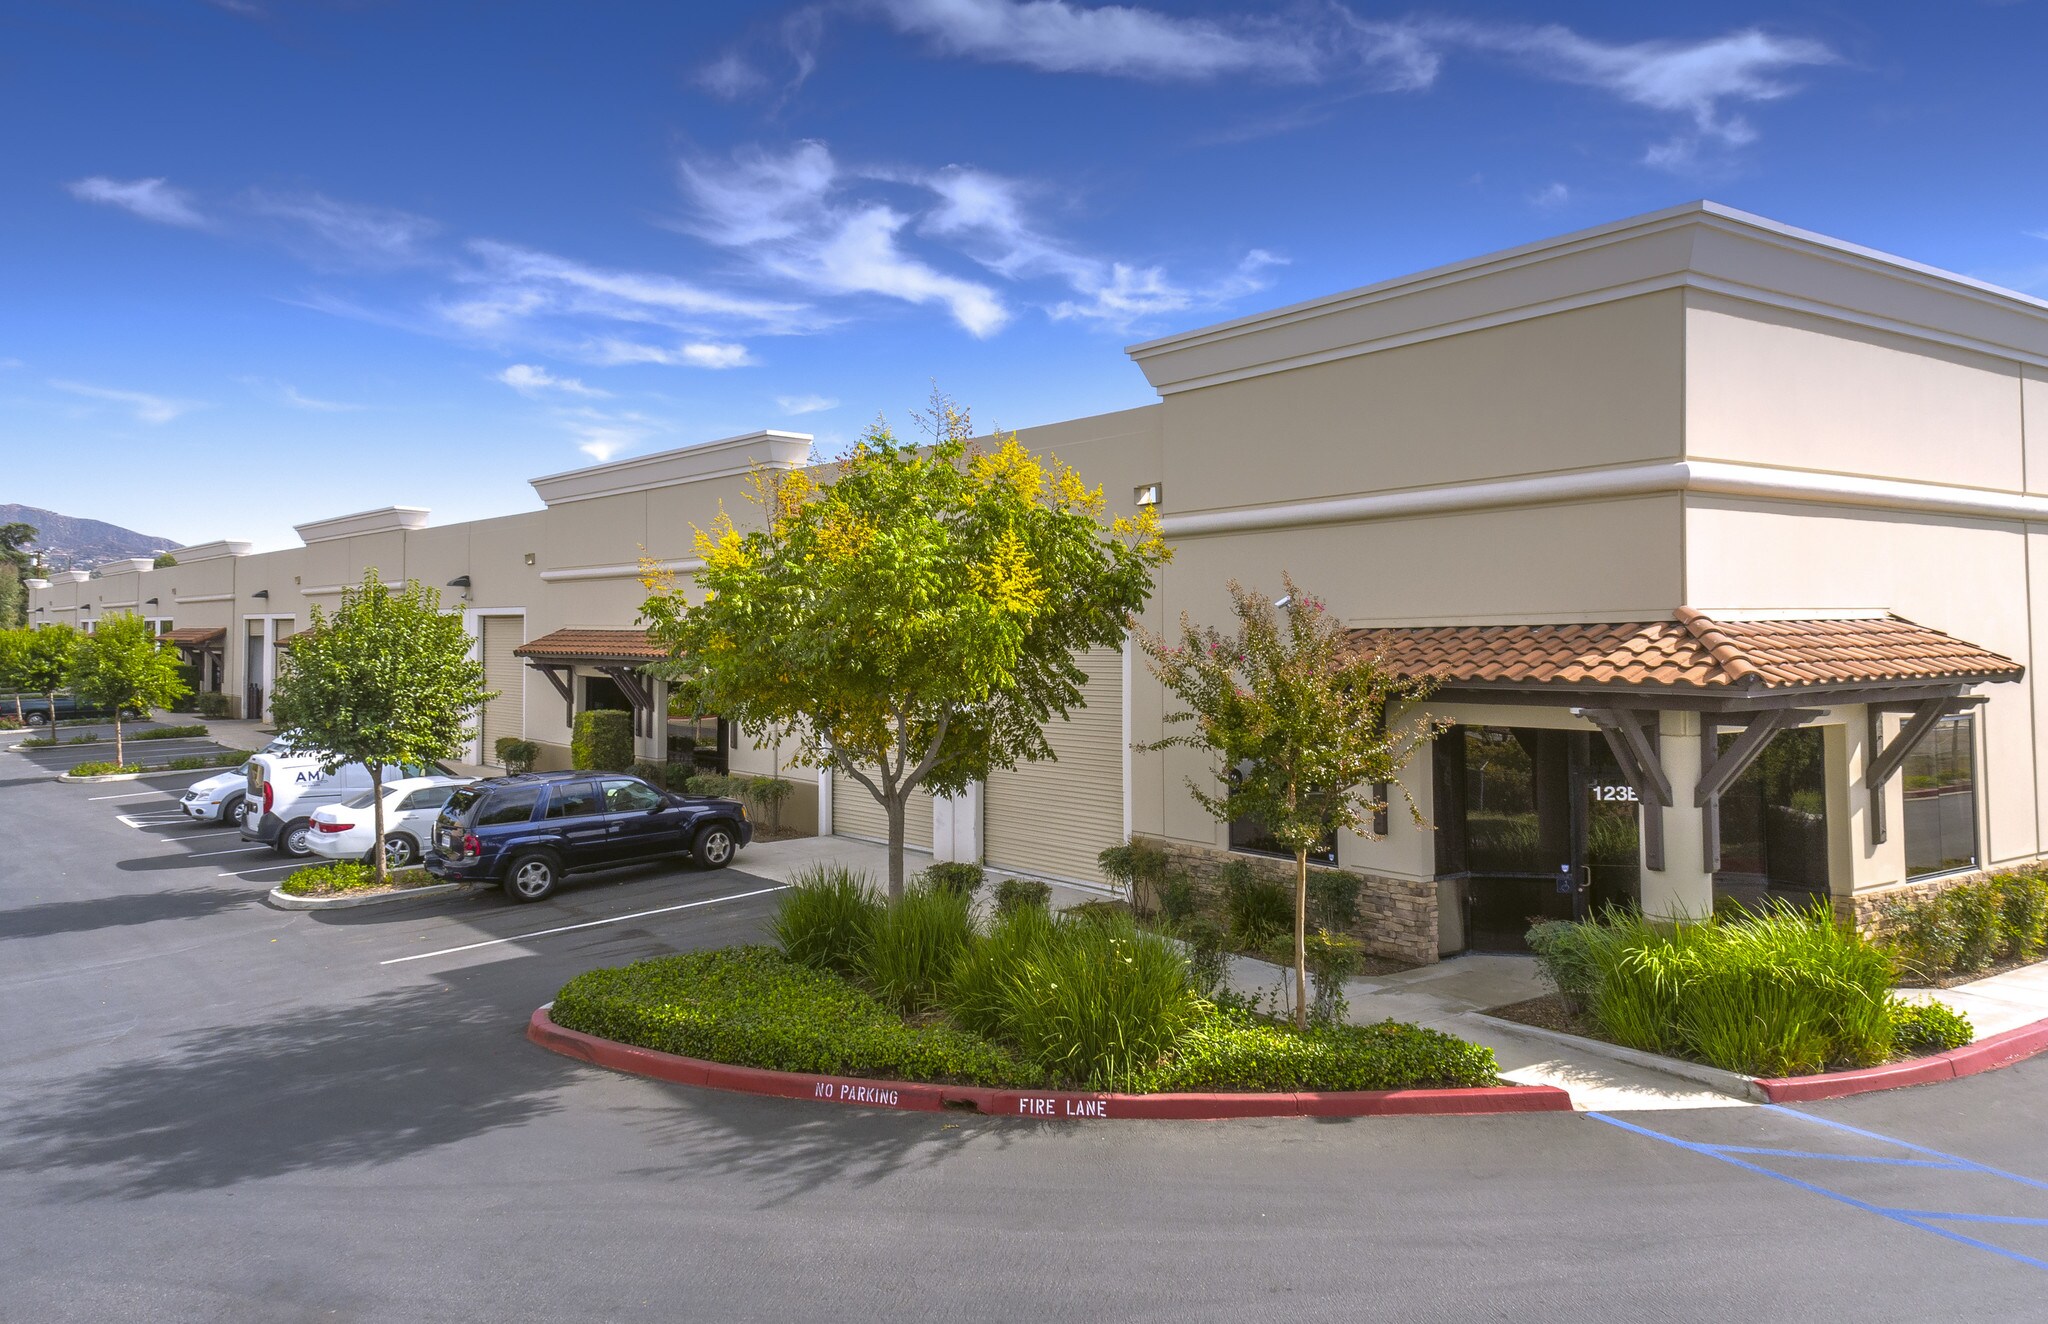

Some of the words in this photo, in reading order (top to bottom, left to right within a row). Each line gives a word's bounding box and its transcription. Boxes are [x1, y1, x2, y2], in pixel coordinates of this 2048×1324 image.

[815, 1082, 834, 1097] NO
[840, 1084, 898, 1105] PARKING
[1020, 1098, 1056, 1115] FIRE
[1066, 1100, 1107, 1117] LANE
